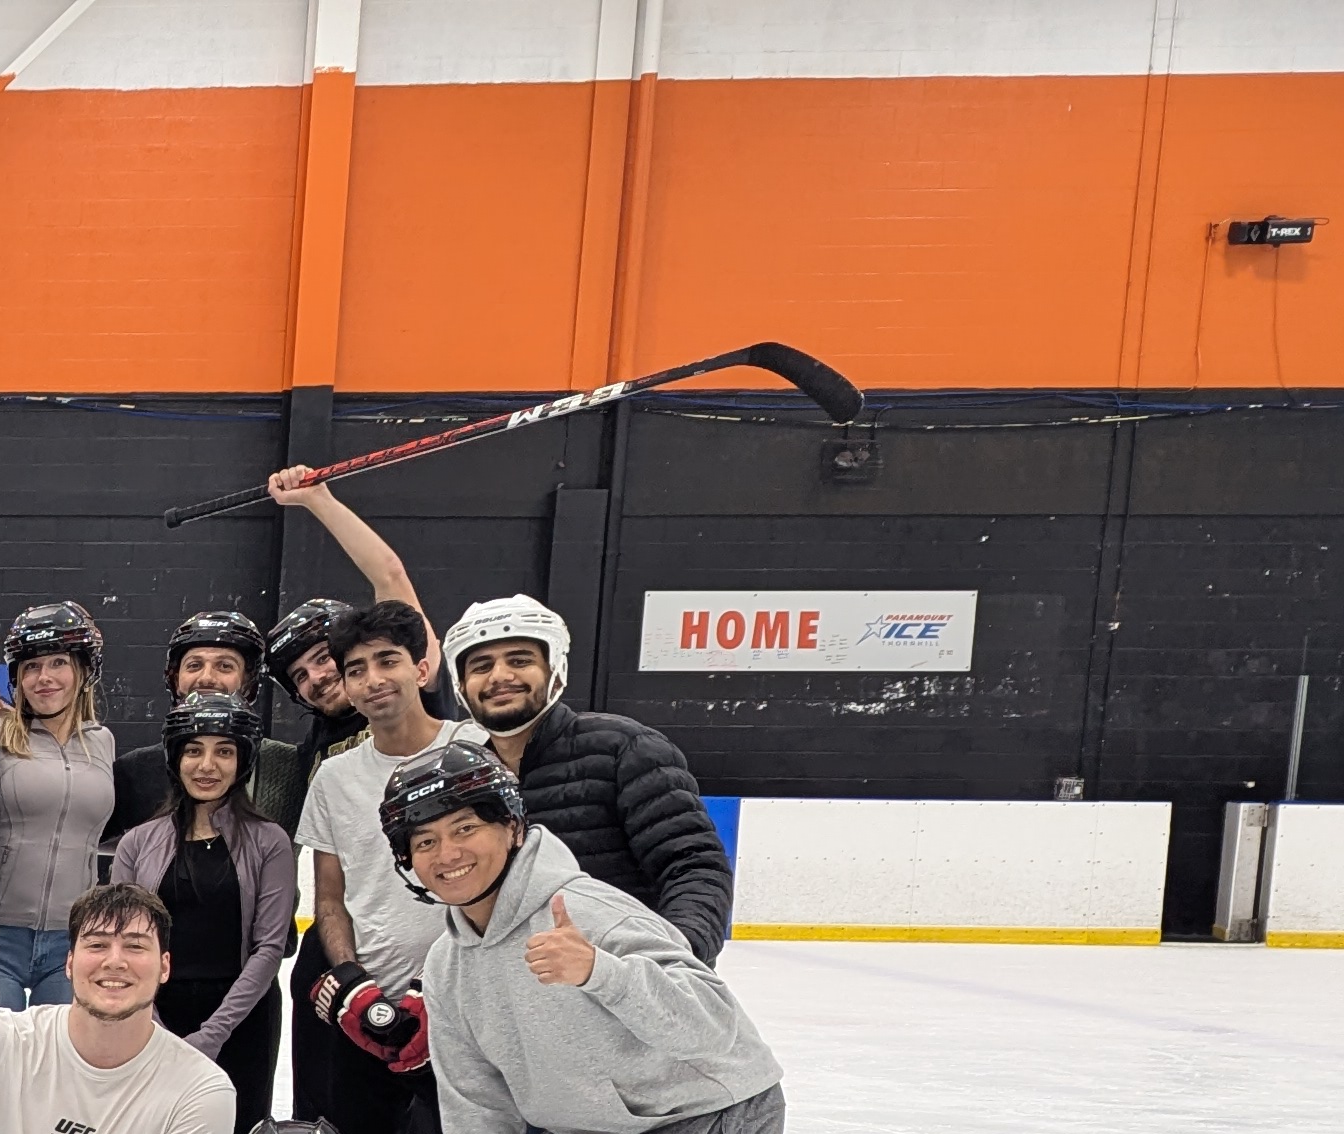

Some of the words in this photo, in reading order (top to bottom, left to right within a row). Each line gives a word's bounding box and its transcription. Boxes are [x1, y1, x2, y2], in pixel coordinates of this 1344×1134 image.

[1270, 226, 1302, 237] T-REX
[885, 614, 954, 622] PARAMOUNT
[680, 610, 821, 650] HOME
[882, 622, 948, 639] ICE
[406, 780, 445, 802] CCM
